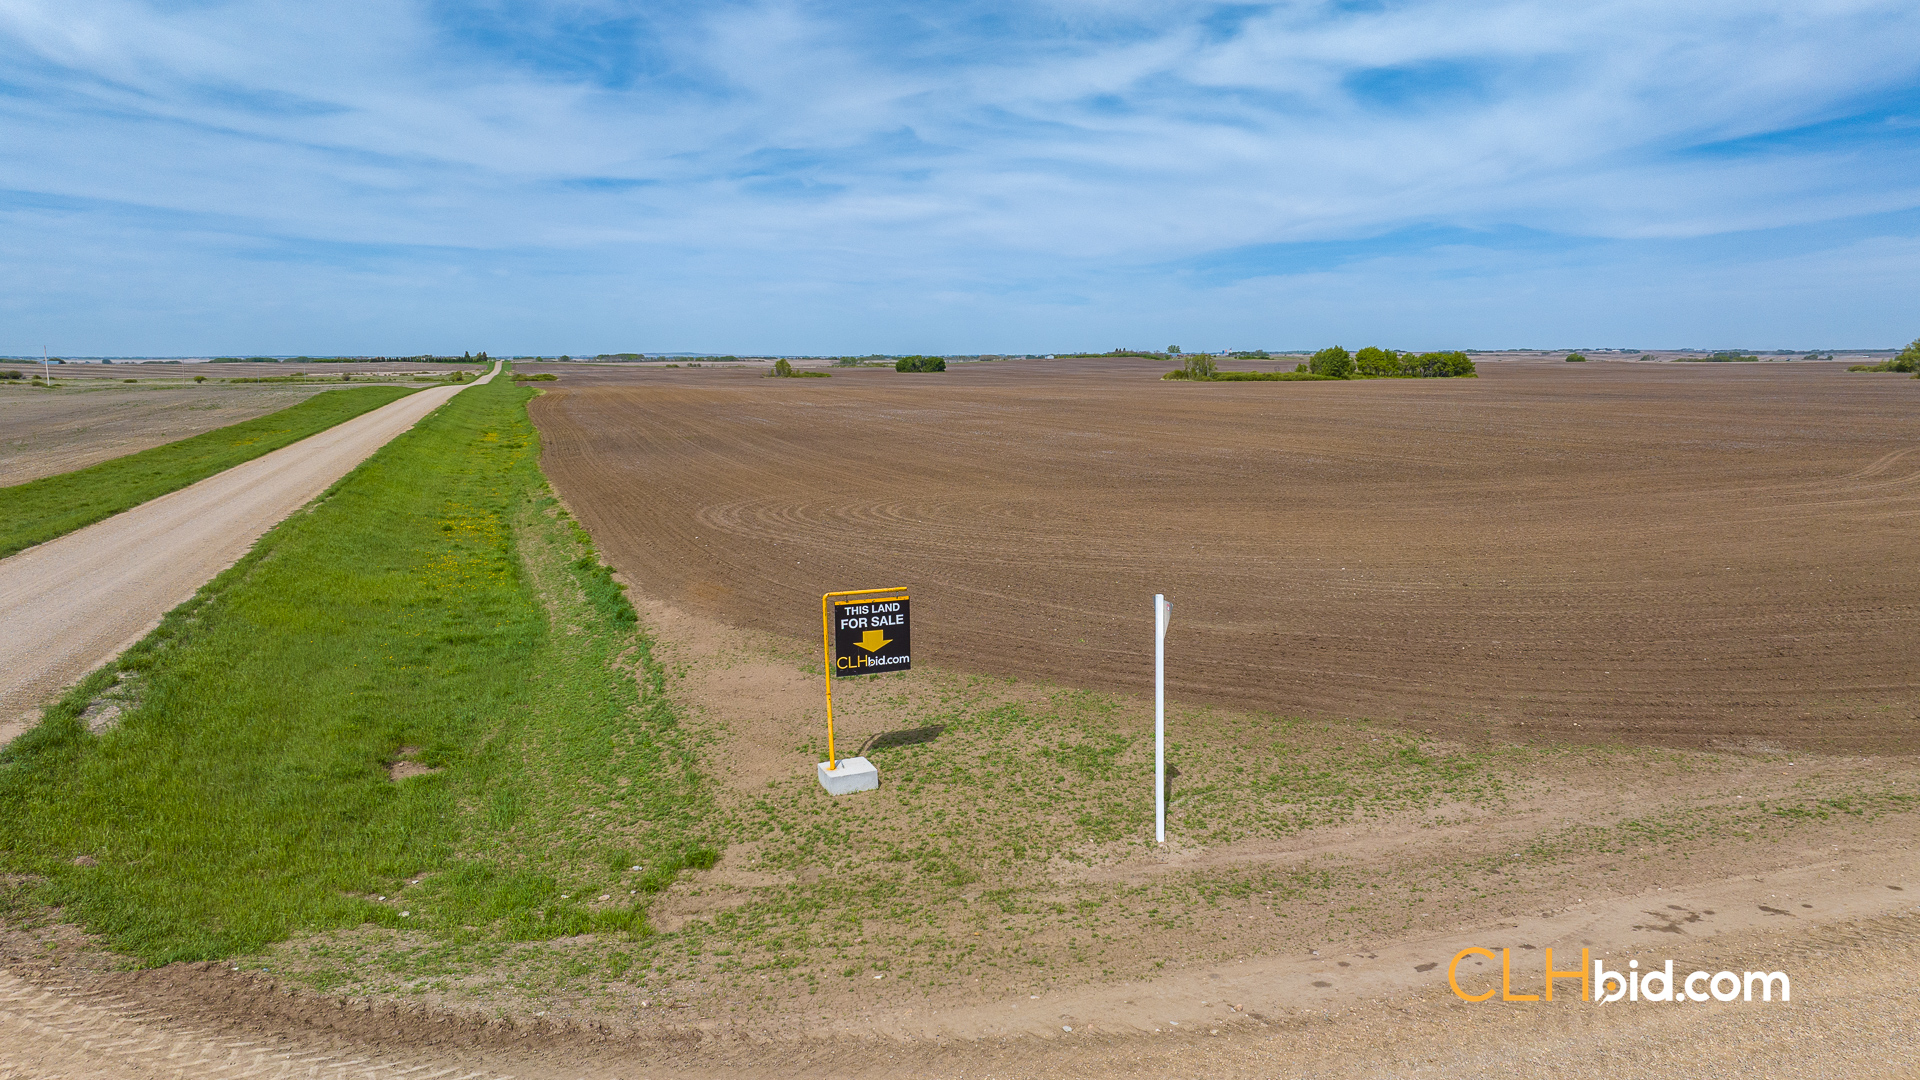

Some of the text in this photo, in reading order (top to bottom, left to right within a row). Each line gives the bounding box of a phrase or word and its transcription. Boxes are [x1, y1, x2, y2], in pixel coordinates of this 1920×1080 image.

[844, 602, 900, 616] THIS LAND
[840, 614, 904, 630] FOR SALE
[836, 655, 910, 670] CLHbid.com
